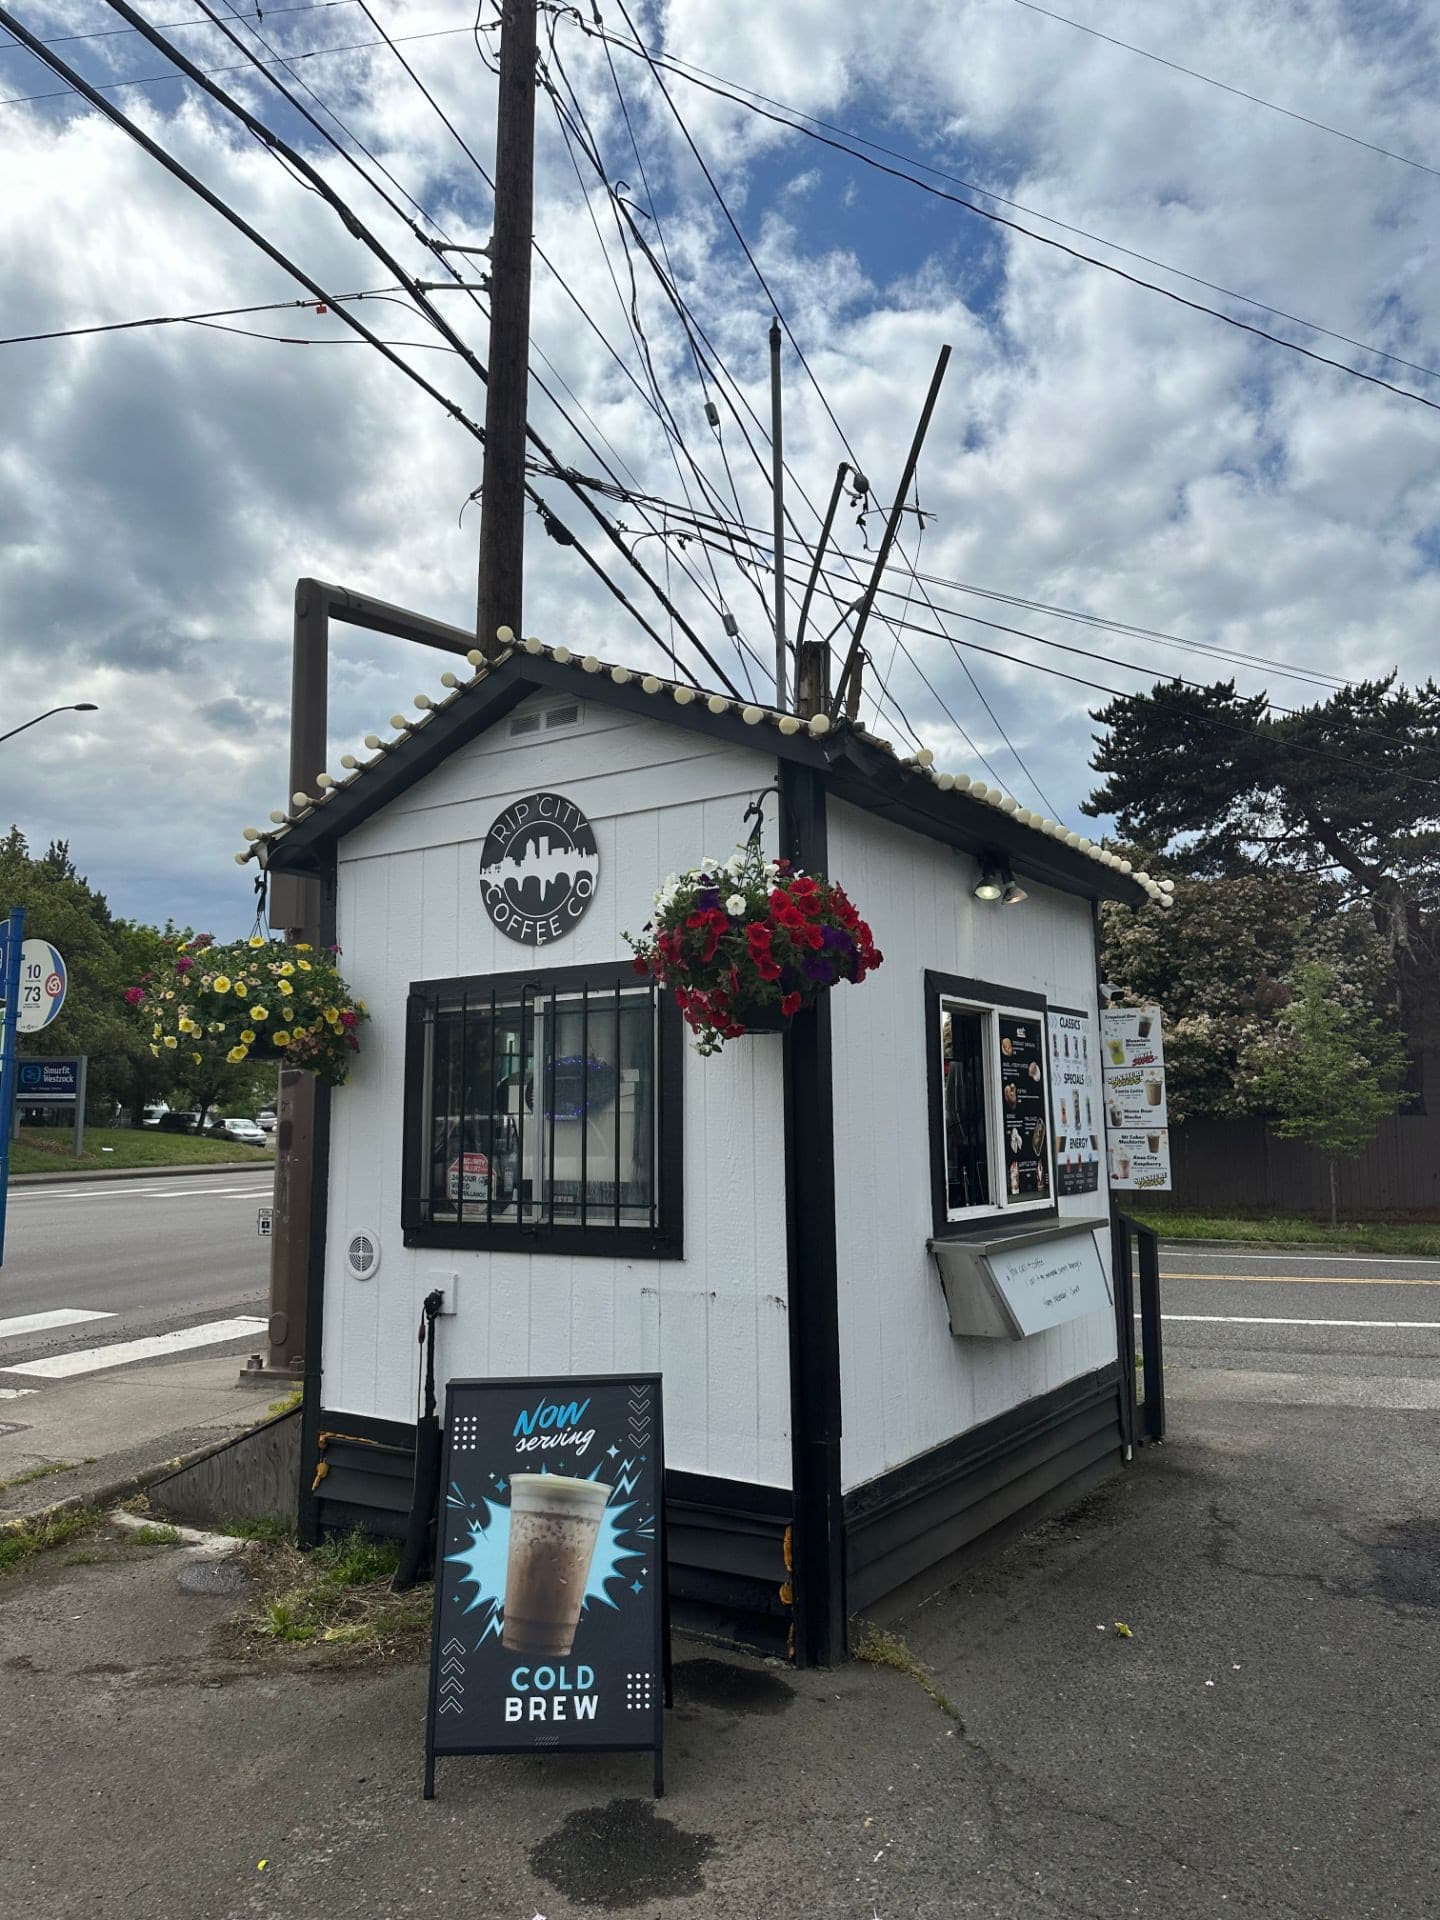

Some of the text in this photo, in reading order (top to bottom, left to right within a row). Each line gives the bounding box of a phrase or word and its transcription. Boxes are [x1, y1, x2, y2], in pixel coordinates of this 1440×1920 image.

[491, 797, 589, 844] RIP CITY
[486, 878, 592, 941] COFFEE CO
[27, 964, 41, 979] 10
[24, 986, 41, 1002] 73
[1059, 1016, 1081, 1030] CLASSICS
[43, 1065, 70, 1074] Smurfit
[43, 1074, 74, 1083] Westrock
[1063, 1073, 1084, 1085] SPECIALS
[1069, 1137, 1088, 1149] ENERGY
[515, 1427, 596, 1456] serving
[511, 1665, 595, 1692] COLD
[505, 1695, 599, 1722] BREW
